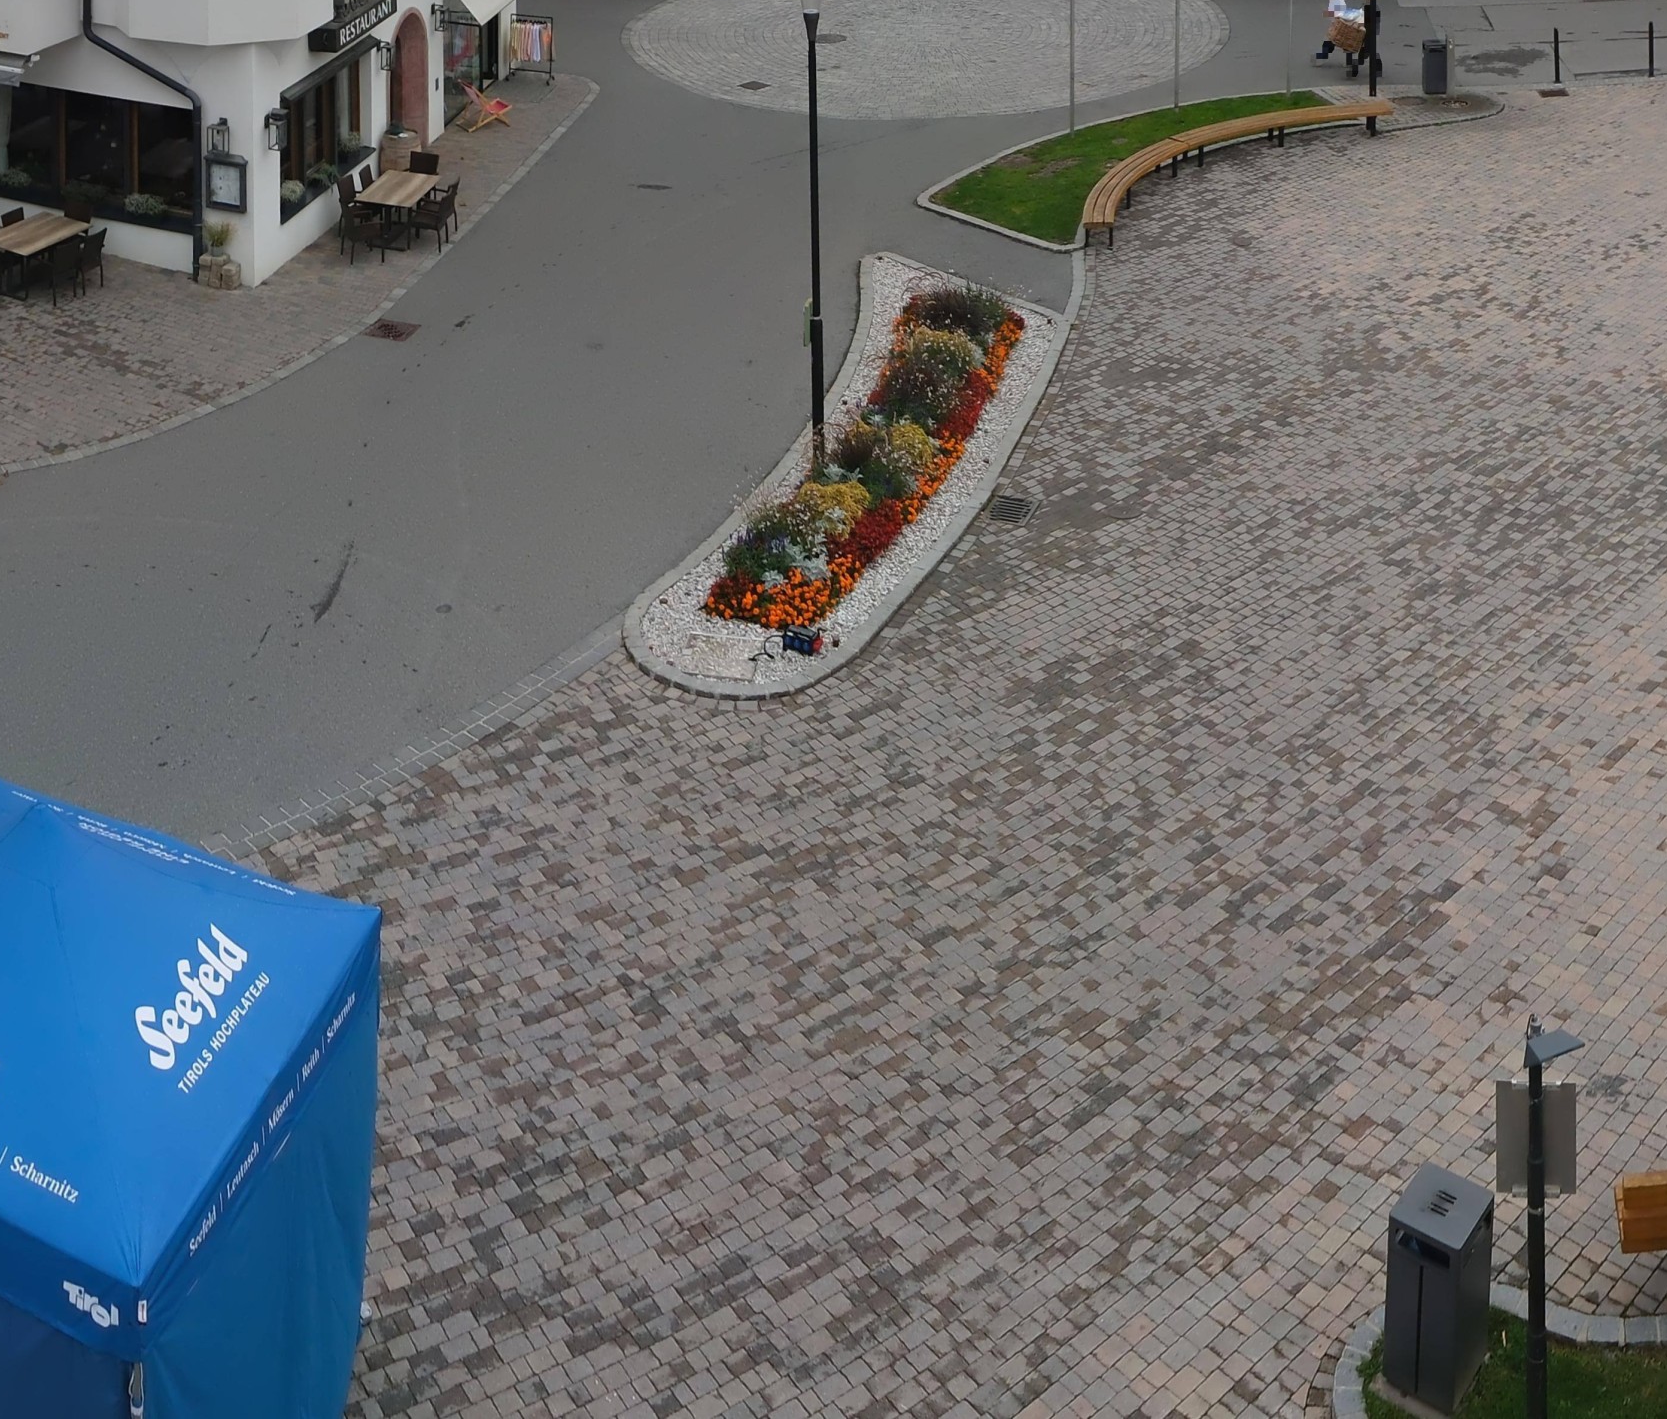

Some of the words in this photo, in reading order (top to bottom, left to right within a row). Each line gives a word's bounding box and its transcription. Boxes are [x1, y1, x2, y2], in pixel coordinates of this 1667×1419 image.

[135, 922, 248, 1070] Seefeld
[177, 1048, 213, 1094] TIROLS
[209, 971, 271, 1052] HOCHPLATEAU
[10, 1155, 79, 1203] Scharnitz
[188, 1205, 217, 1257] Seefeld
[225, 1141, 260, 1200] Leutasch
[267, 1090, 295, 1134] Mösern
[302, 1048, 320, 1082] Reith
[326, 992, 357, 1042] Scharnitz
[63, 1280, 119, 1328] Tirol
